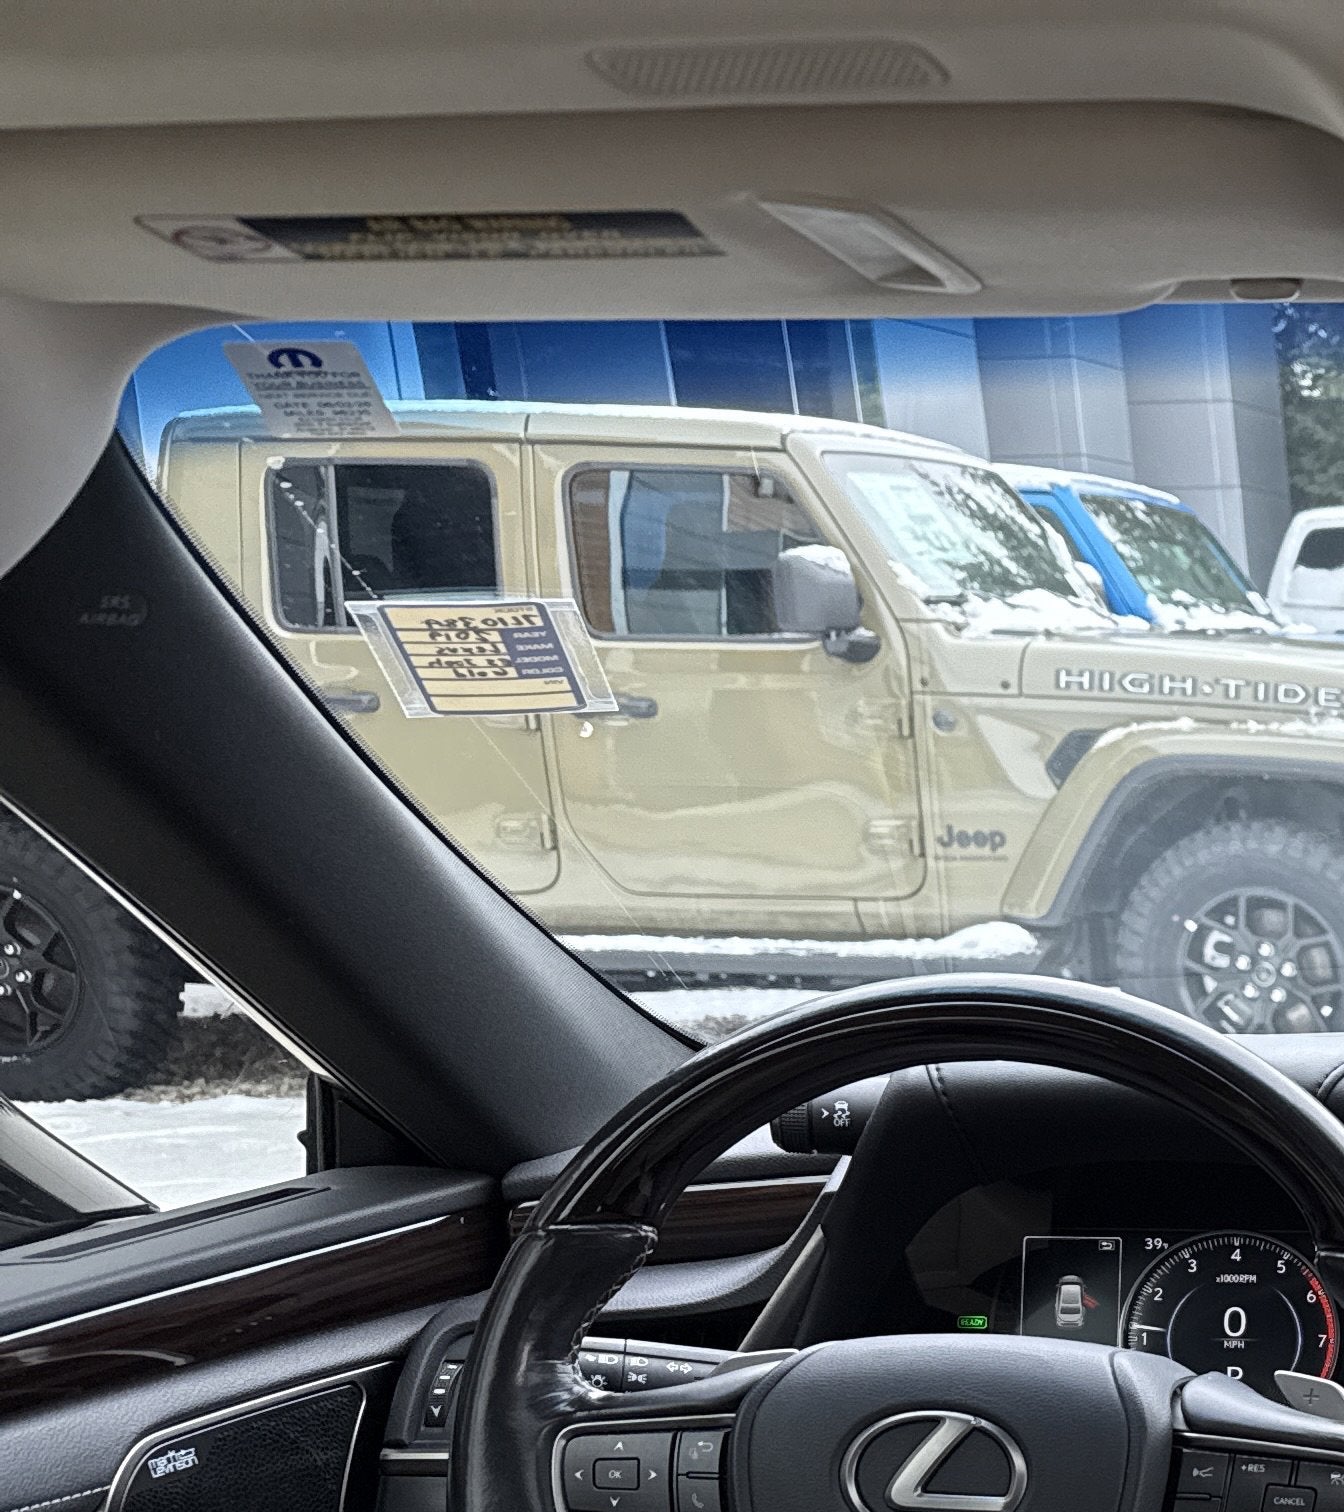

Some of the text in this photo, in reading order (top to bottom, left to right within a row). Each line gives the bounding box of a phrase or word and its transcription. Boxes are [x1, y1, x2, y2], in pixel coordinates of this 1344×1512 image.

[937, 824, 1007, 852] Jeep
[833, 1118, 850, 1127] OFF
[1230, 1248, 1242, 1262] 4
[1187, 1259, 1197, 1273] 3
[1276, 1260, 1287, 1273] 5
[1153, 1287, 1163, 1301] 2
[1306, 1290, 1317, 1303] 6
[959, 1317, 986, 1328] READY
[1222, 1306, 1247, 1338] 0
[1140, 1331, 1149, 1346] 1
[1223, 1340, 1245, 1350] MPH
[1318, 1335, 1328, 1349] 7
[608, 1470, 623, 1480] OK
[1273, 1496, 1306, 1506] CANCEL
